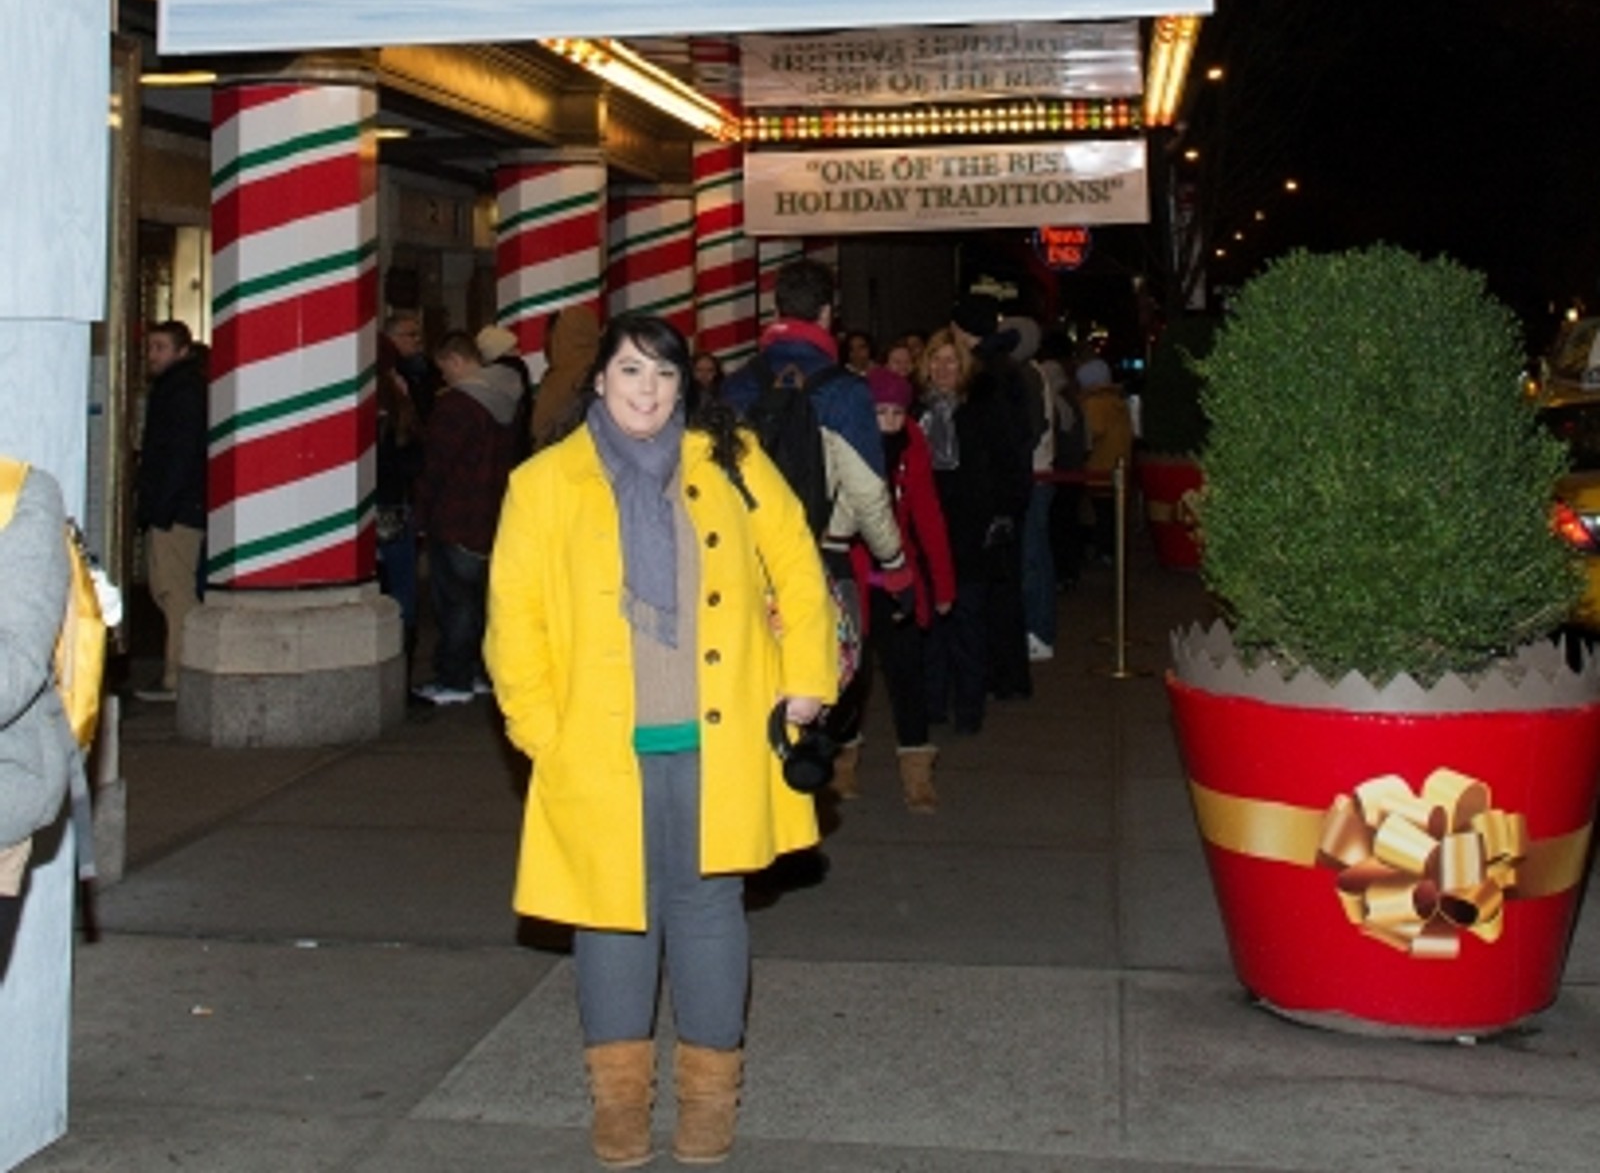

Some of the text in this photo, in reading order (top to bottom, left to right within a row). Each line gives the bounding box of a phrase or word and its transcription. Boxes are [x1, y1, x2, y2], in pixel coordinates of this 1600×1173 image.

[892, 155, 932, 180] OF
[936, 154, 999, 177] THE
[774, 177, 1124, 216] HOLIDAY TRADITIONS!”
